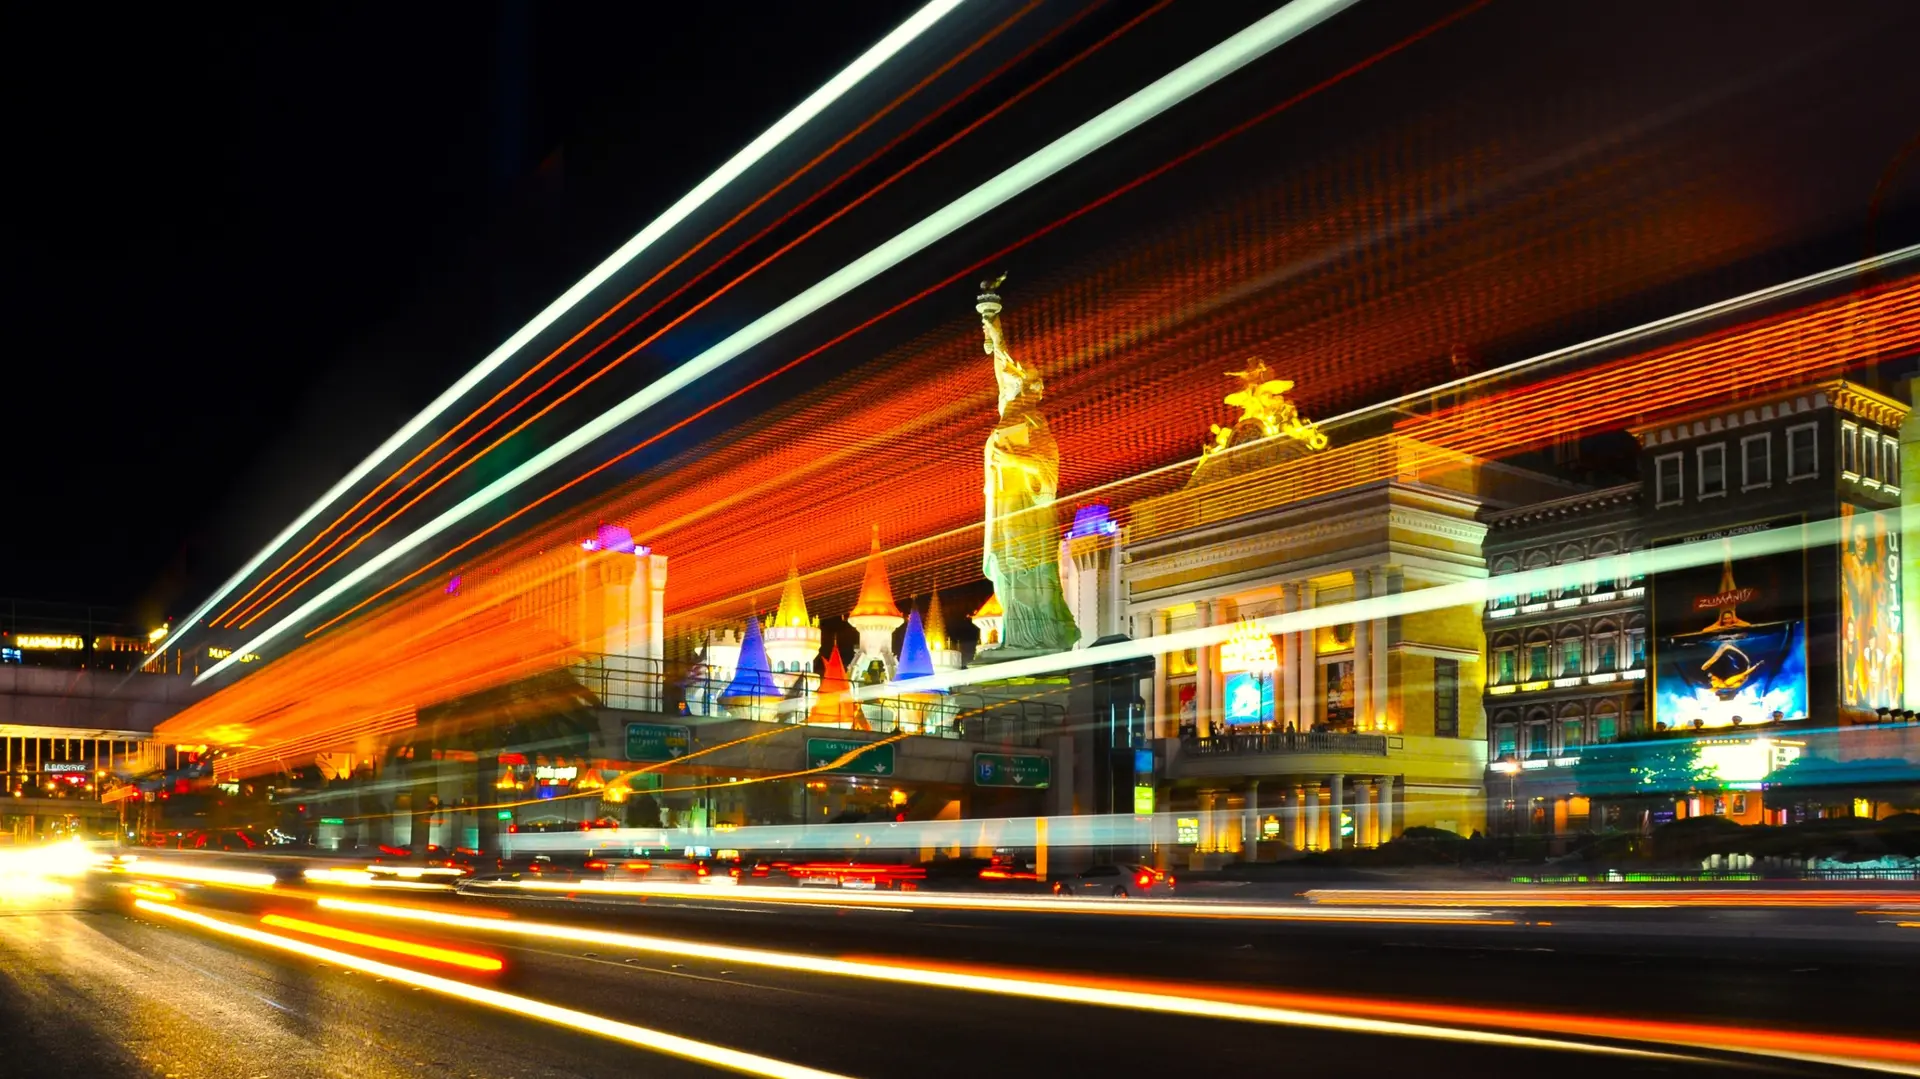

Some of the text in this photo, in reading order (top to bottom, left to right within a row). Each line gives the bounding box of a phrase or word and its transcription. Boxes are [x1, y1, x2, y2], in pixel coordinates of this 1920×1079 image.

[1707, 531, 1722, 540] FUN
[1728, 522, 1770, 537] ACROBATIC
[1699, 588, 1754, 608] ZUMANITY
[981, 764, 992, 776] 15
